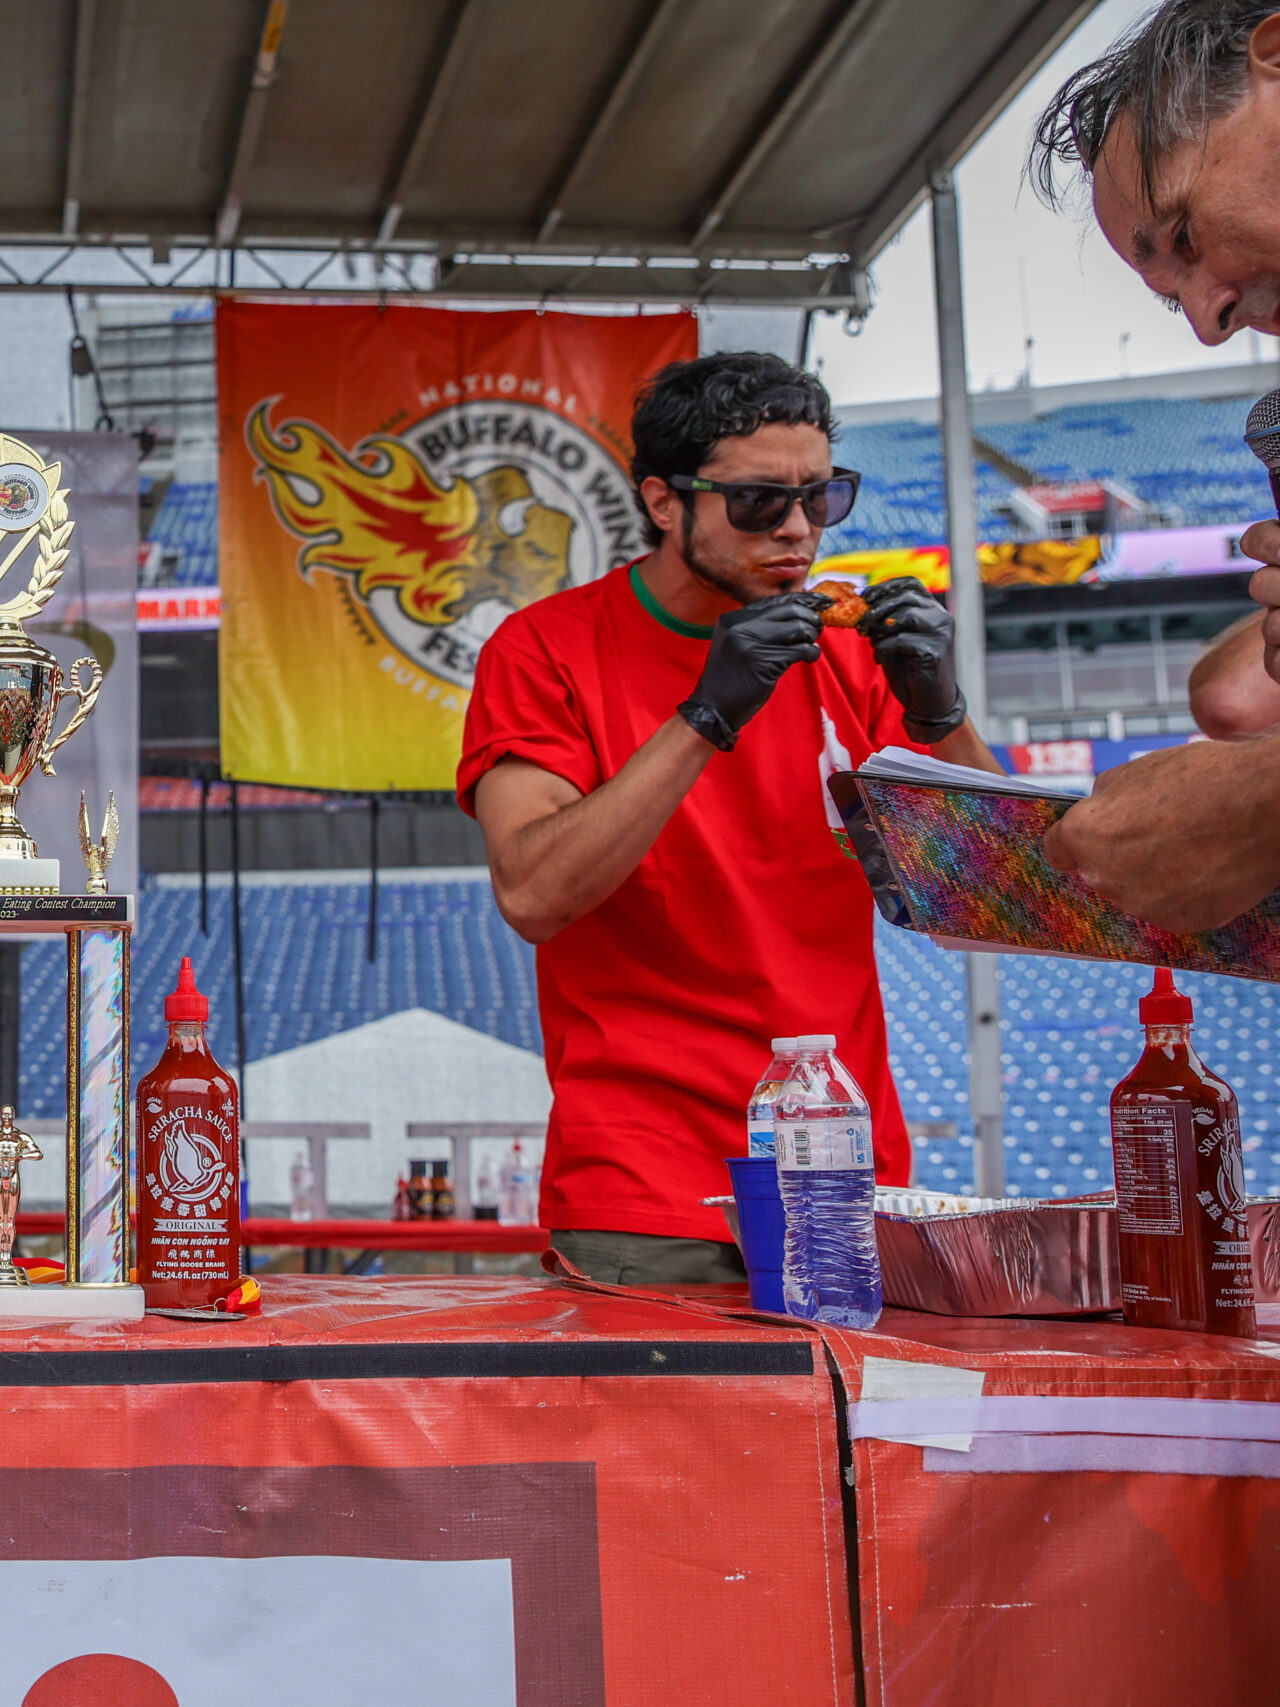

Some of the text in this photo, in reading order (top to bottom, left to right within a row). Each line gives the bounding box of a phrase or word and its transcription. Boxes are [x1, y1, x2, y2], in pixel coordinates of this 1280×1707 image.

[419, 372, 578, 413] NATIONAL
[419, 412, 587, 472] BUFFALO
[377, 653, 470, 714] BUFFA
[2, 898, 31, 911] Eating
[34, 897, 68, 909] Contest
[71, 898, 116, 912] Champion
[148, 1106, 203, 1142] SRIRACHA
[205, 1110, 233, 1143] SAUCE
[1191, 1107, 1214, 1116] VEGAN
[1198, 1117, 1239, 1157] SRIRACH
[165, 1222, 217, 1231] ORIGINAL
[171, 1238, 188, 1246] CON
[1229, 1244, 1250, 1253] ORIG
